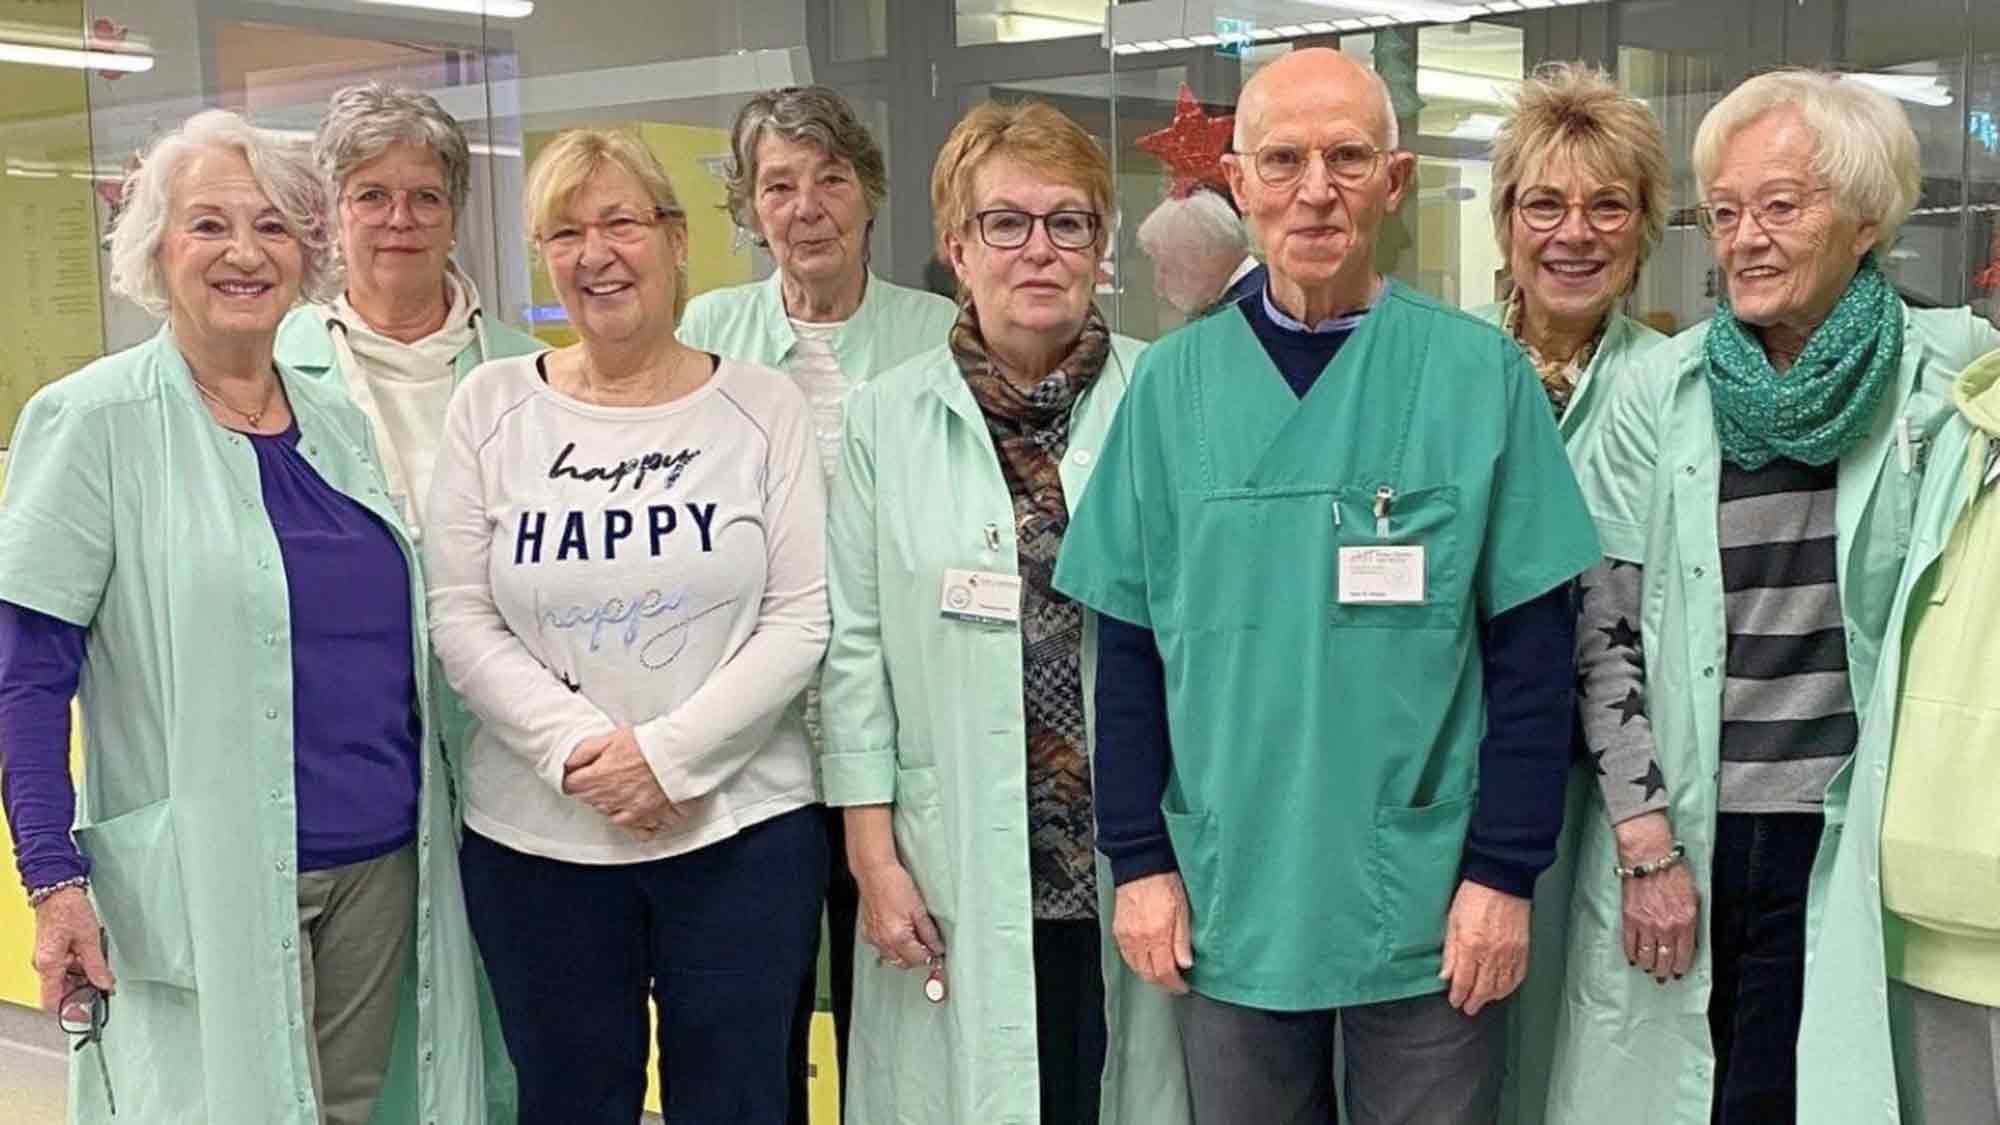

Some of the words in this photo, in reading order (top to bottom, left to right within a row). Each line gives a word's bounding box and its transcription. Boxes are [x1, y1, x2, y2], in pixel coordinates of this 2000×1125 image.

[549, 442, 701, 492] happy
[514, 502, 718, 565] HAPPY
[534, 586, 740, 671] happy
